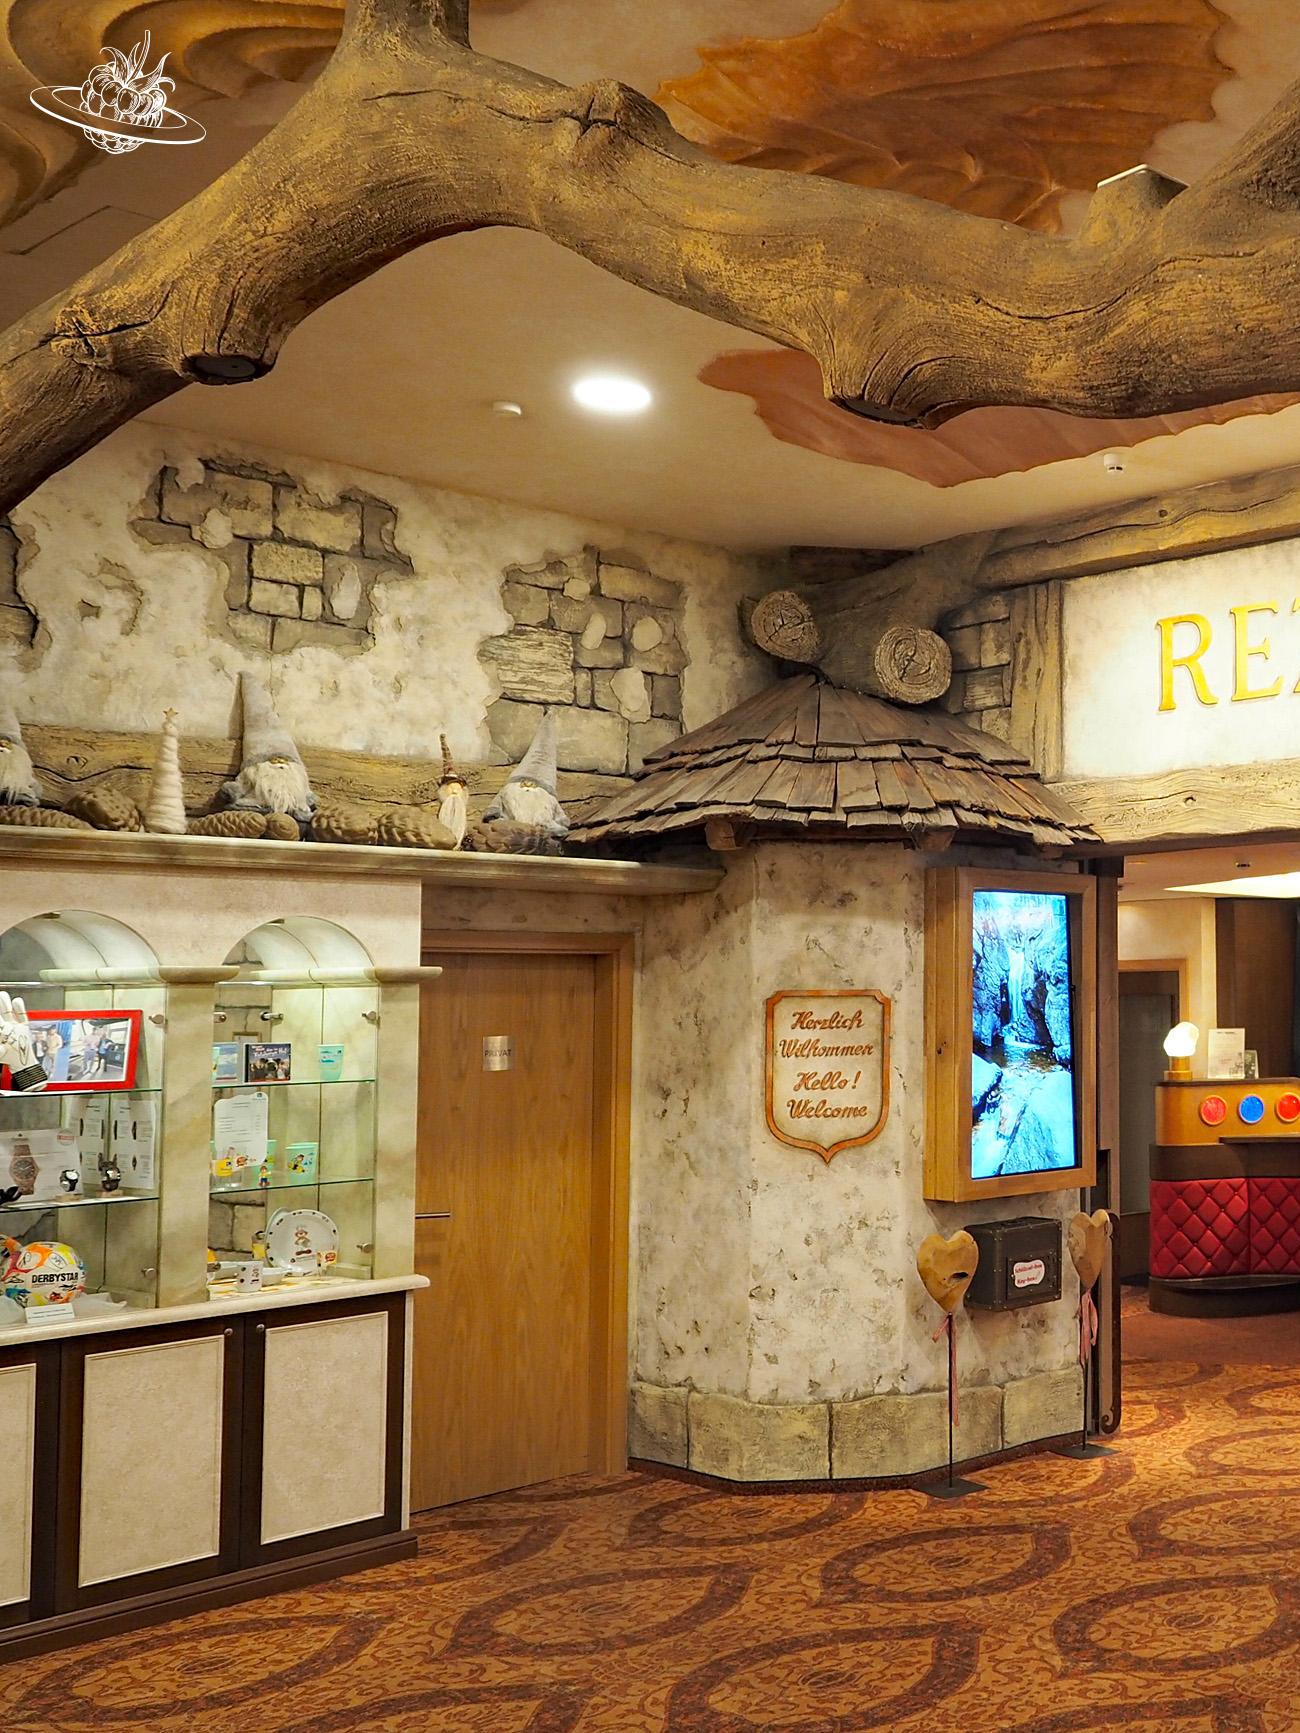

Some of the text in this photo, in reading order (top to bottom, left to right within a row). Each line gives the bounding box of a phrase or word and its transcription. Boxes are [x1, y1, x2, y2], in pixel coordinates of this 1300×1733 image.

[791, 1009, 864, 1031] Herzlich
[787, 1099, 868, 1119] Welcome
[31, 1272, 79, 1284] DERBYSTAR
